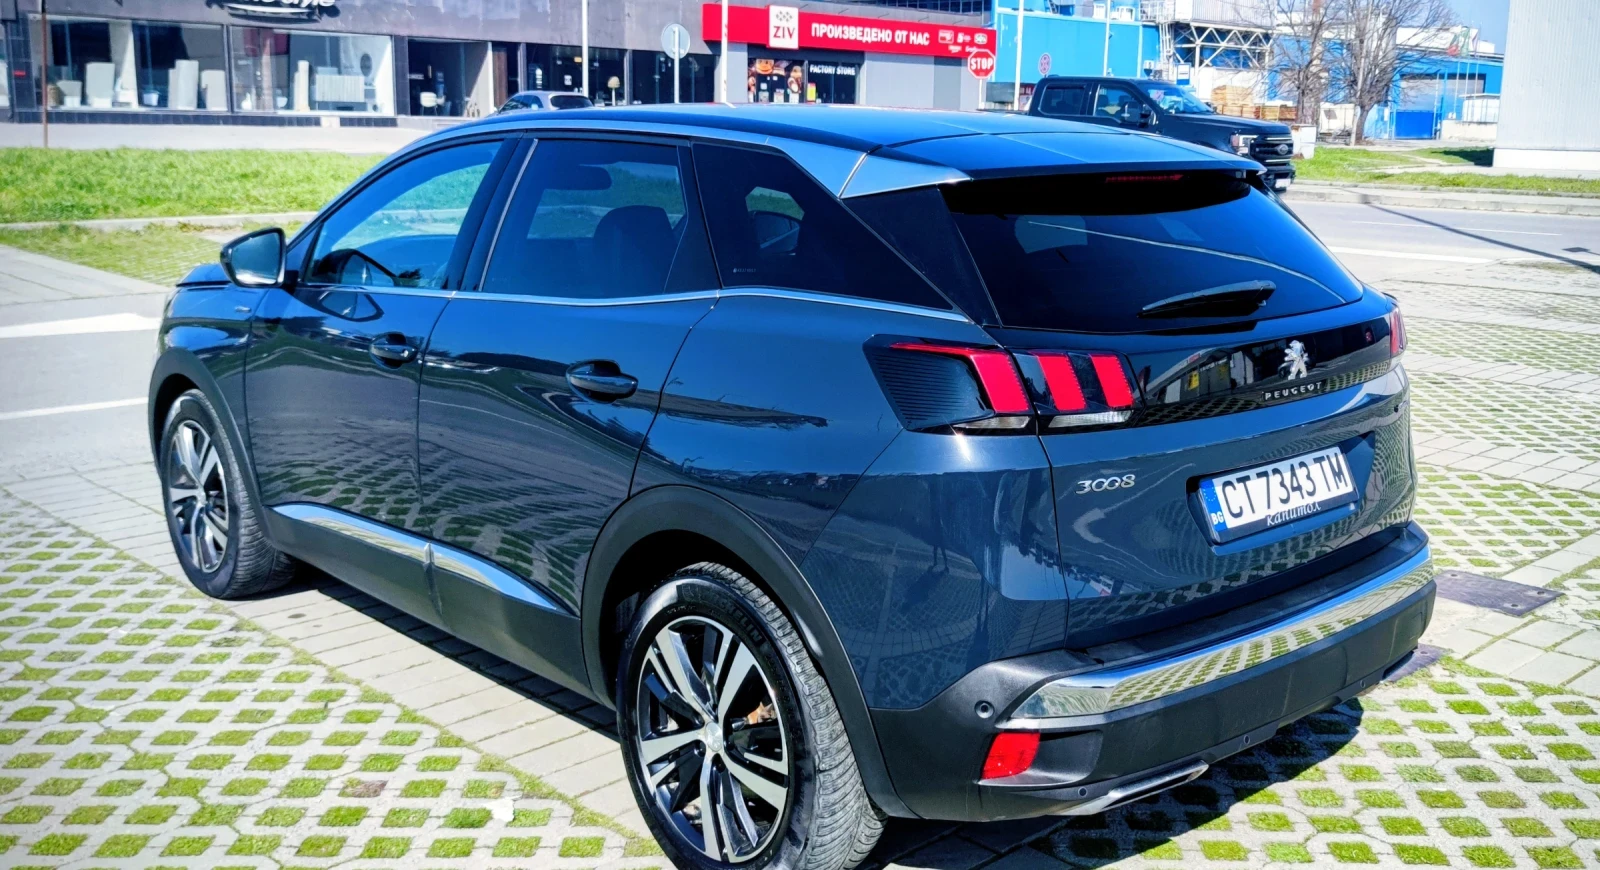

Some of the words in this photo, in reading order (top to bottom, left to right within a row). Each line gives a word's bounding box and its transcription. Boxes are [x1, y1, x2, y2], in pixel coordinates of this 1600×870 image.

[773, 26, 795, 39] ZIV
[811, 22, 892, 43] ПРОИЗВЕДЕНО
[894, 30, 908, 44] ОТ
[909, 32, 930, 46] НАС
[809, 64, 835, 74] FACTORY
[836, 66, 856, 76] STORE
[970, 57, 993, 70] STOP
[1265, 381, 1322, 400] PEUGEOT
[1075, 474, 1136, 495] 3008
[1221, 474, 1256, 519] CT
[1256, 461, 1317, 510] 7343
[1313, 453, 1349, 492] TM
[1211, 512, 1225, 526] BG
